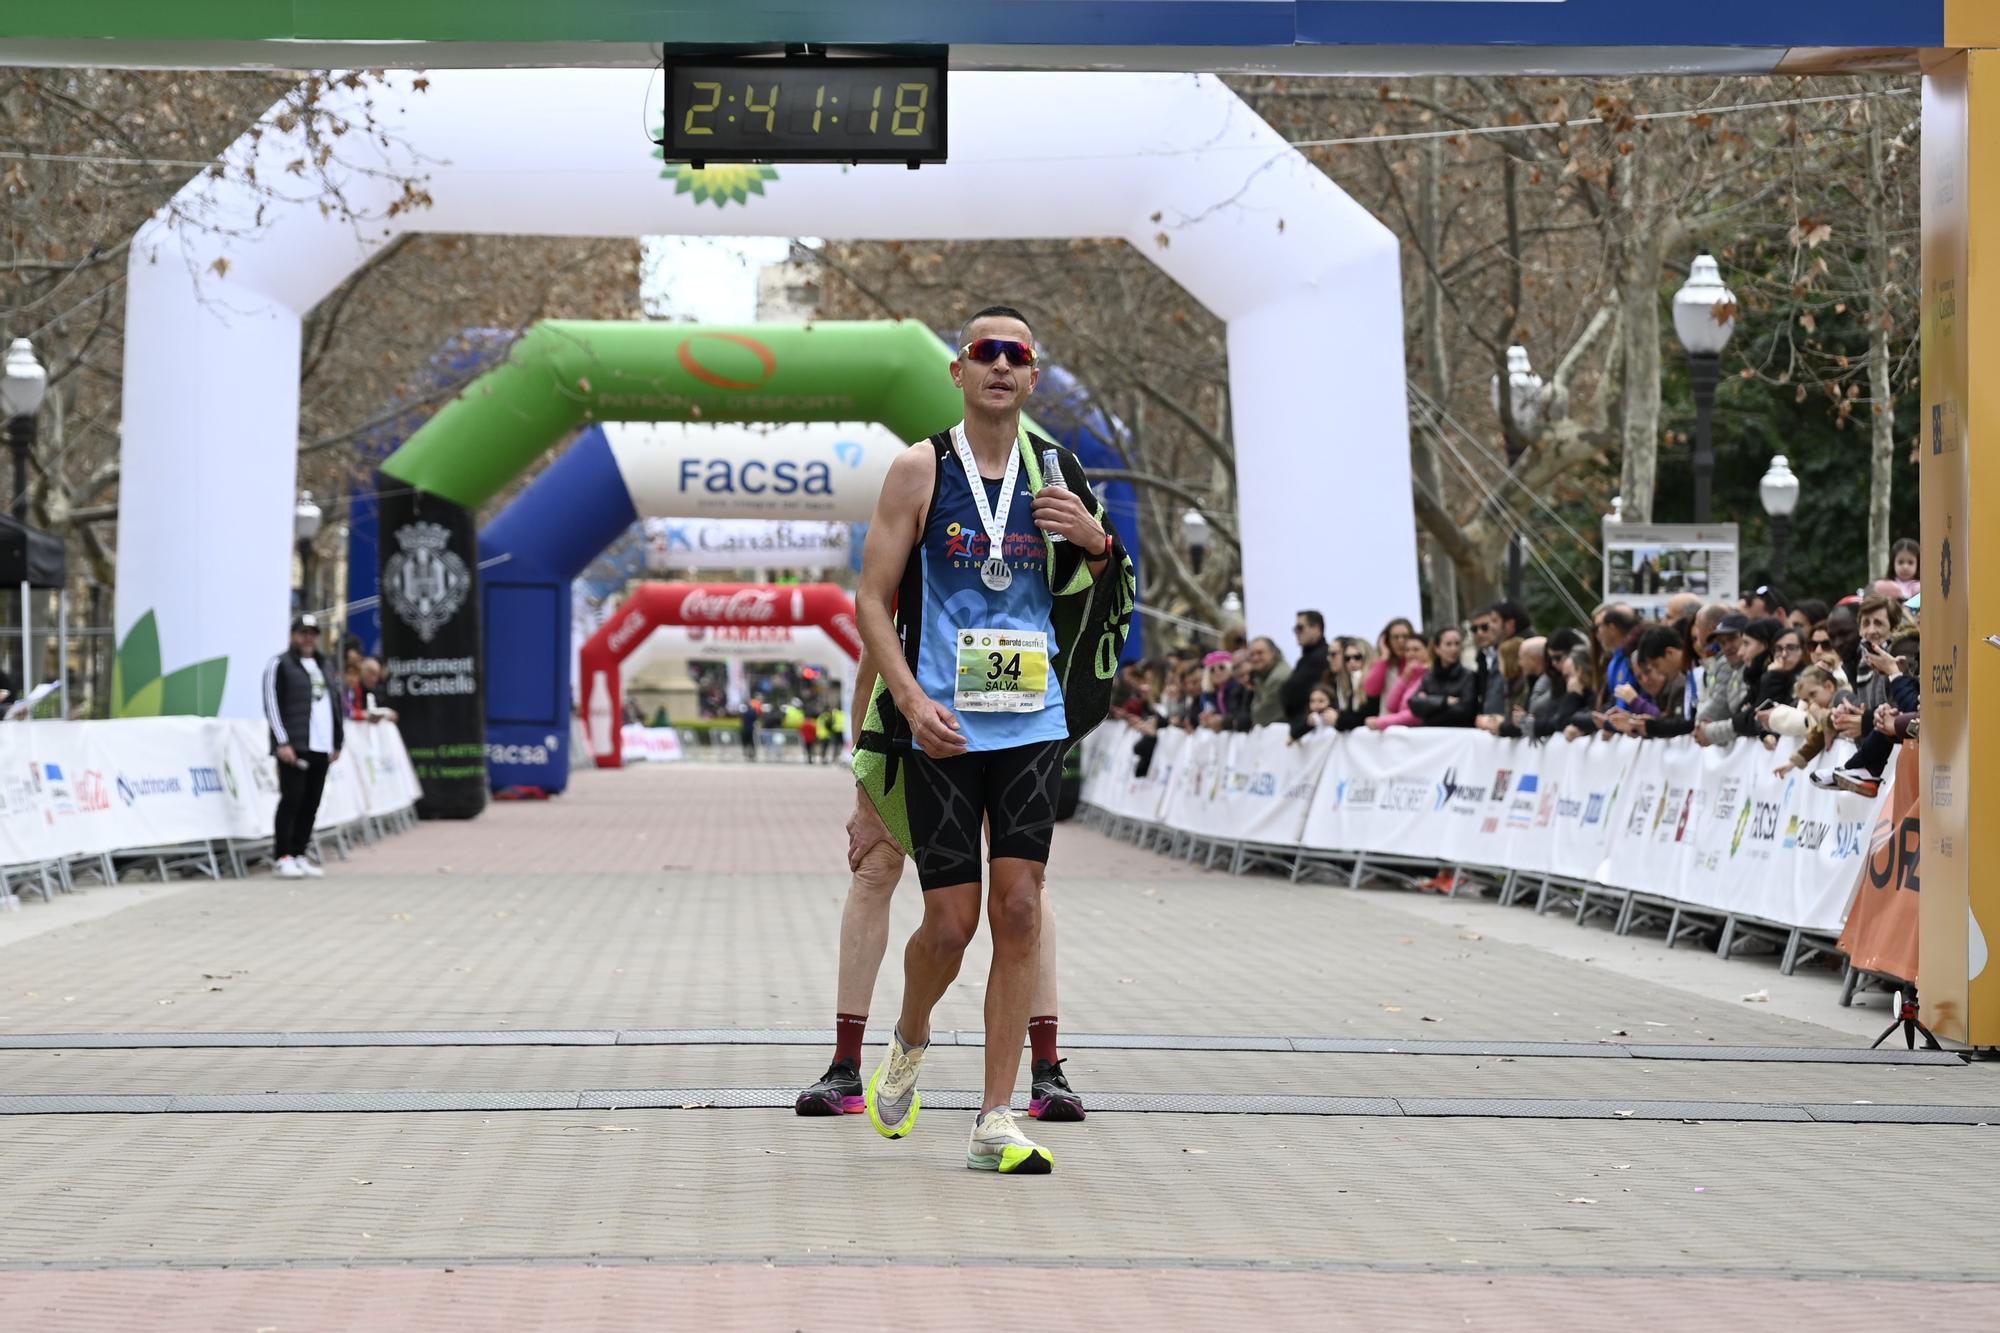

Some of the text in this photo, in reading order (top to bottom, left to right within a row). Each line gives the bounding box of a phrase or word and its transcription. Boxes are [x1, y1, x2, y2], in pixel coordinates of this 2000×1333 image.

[684, 82, 928, 136] 2:41:18
[986, 652, 1022, 680] 34
[985, 681, 1019, 692] SALVA
